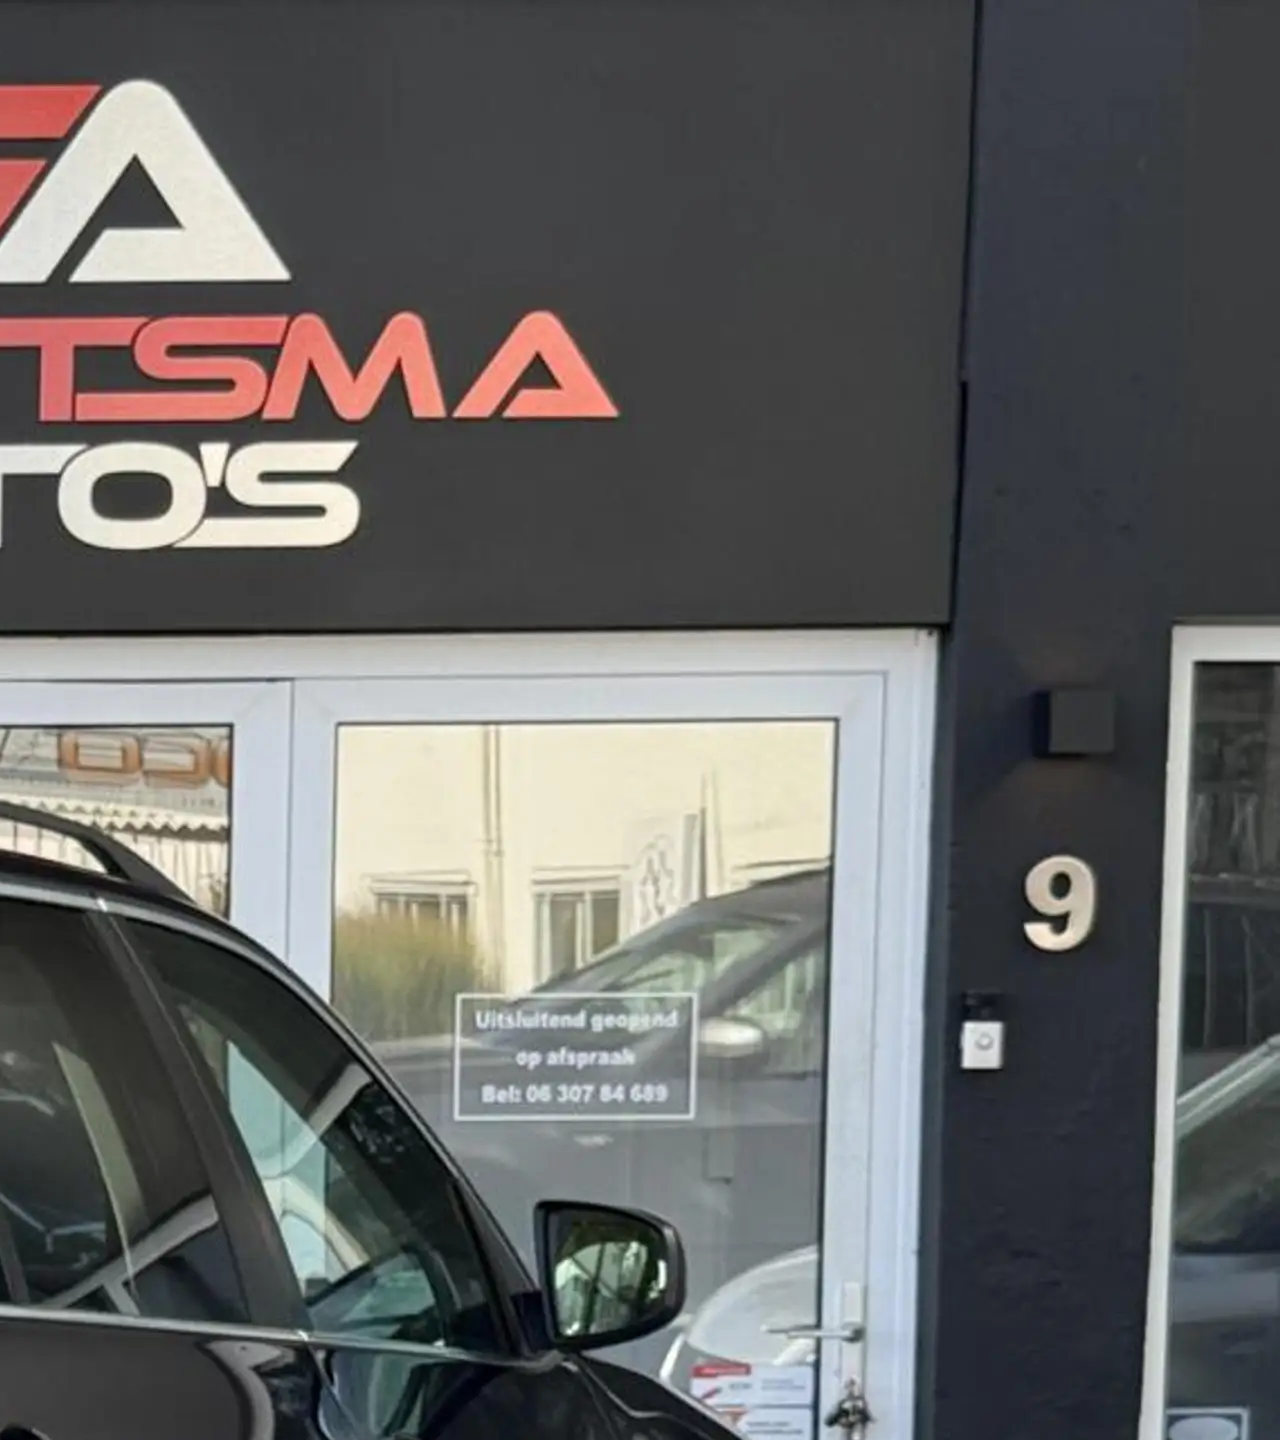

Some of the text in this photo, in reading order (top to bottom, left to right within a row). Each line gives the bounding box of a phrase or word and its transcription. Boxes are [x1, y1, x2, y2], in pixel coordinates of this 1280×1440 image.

[1023, 854, 1096, 951] 9
[475, 1010, 679, 1033] Uitsluitend geopend
[515, 1047, 637, 1070] op afspraak
[481, 1085, 522, 1103] Bel:
[557, 1085, 594, 1103] 307
